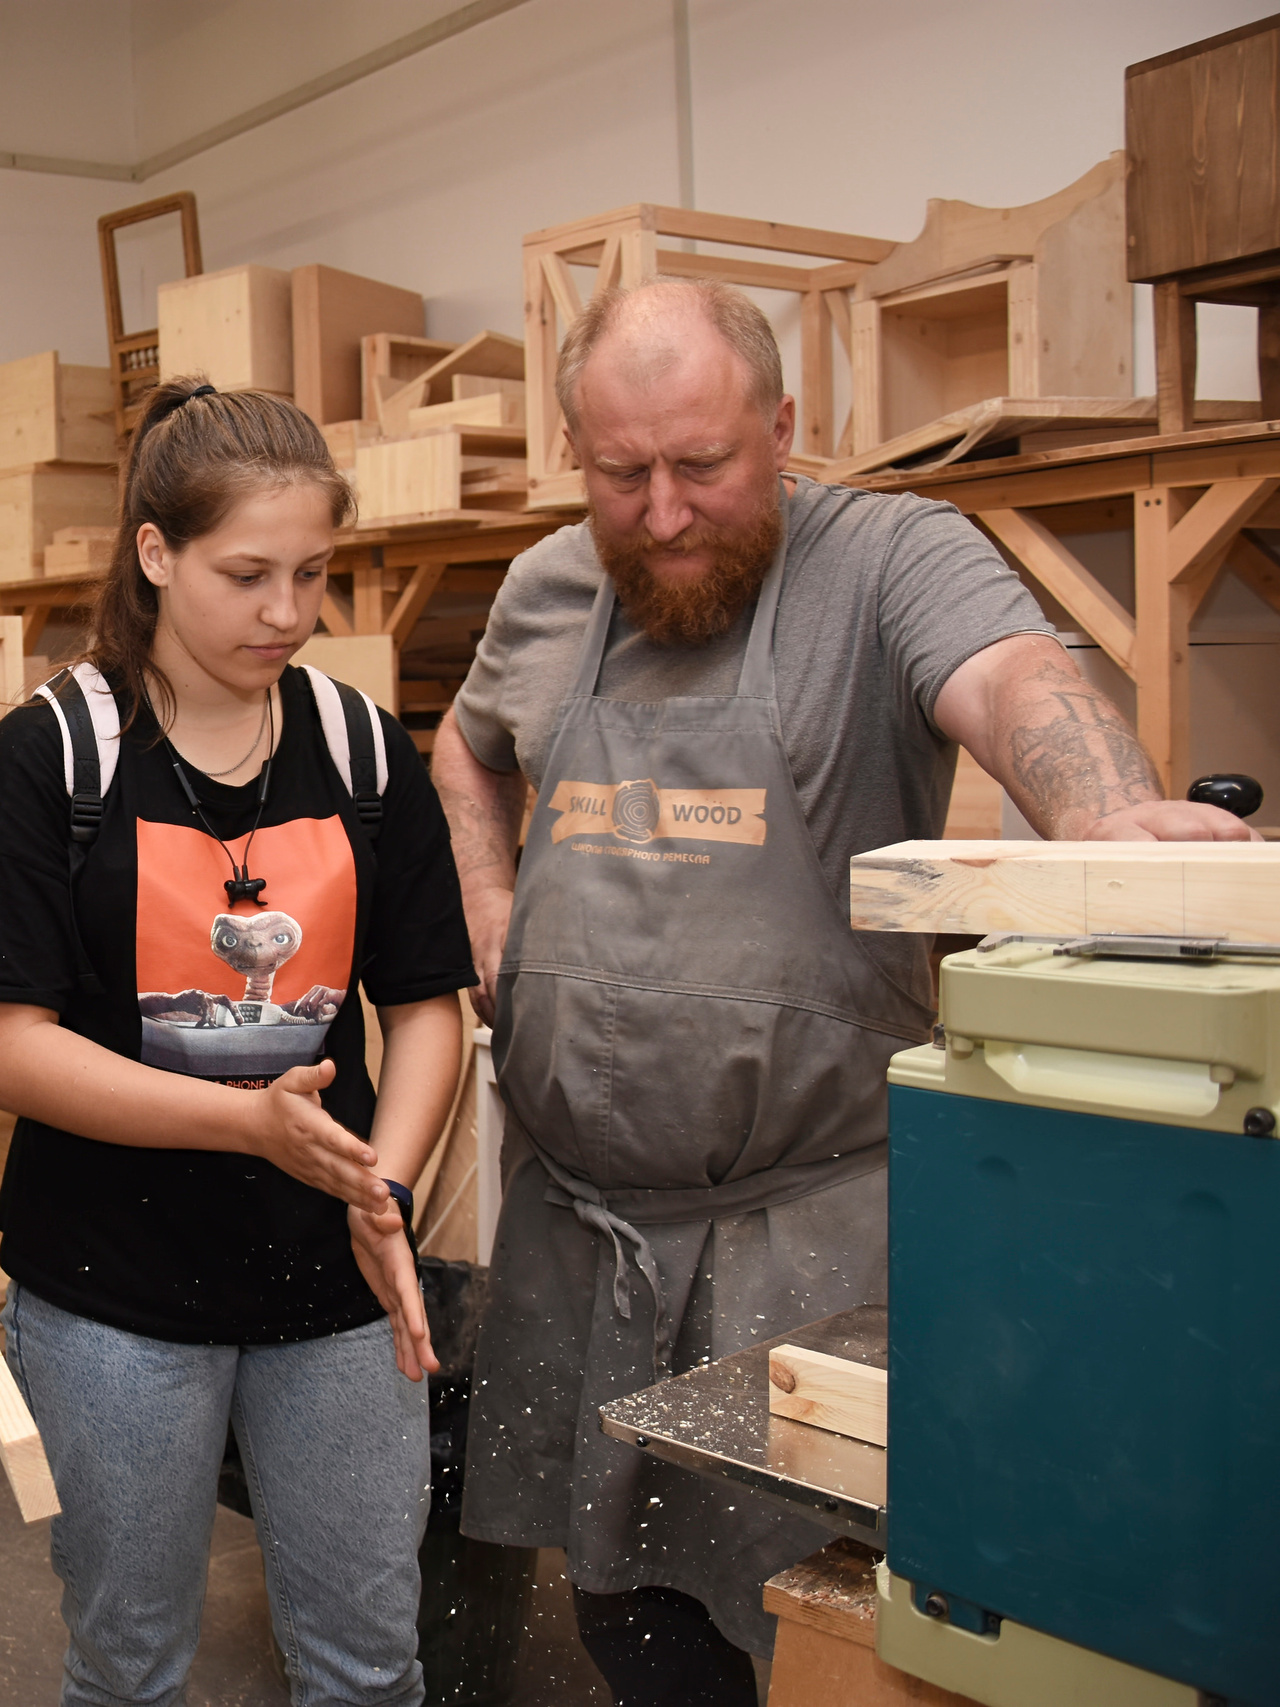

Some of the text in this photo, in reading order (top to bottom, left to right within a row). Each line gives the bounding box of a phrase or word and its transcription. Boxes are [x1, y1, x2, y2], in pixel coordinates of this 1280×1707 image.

[569, 795, 742, 825] SKILL WOOD
[663, 852, 711, 865] РЕМЕСЛА
[226, 1080, 265, 1090] PHONE
